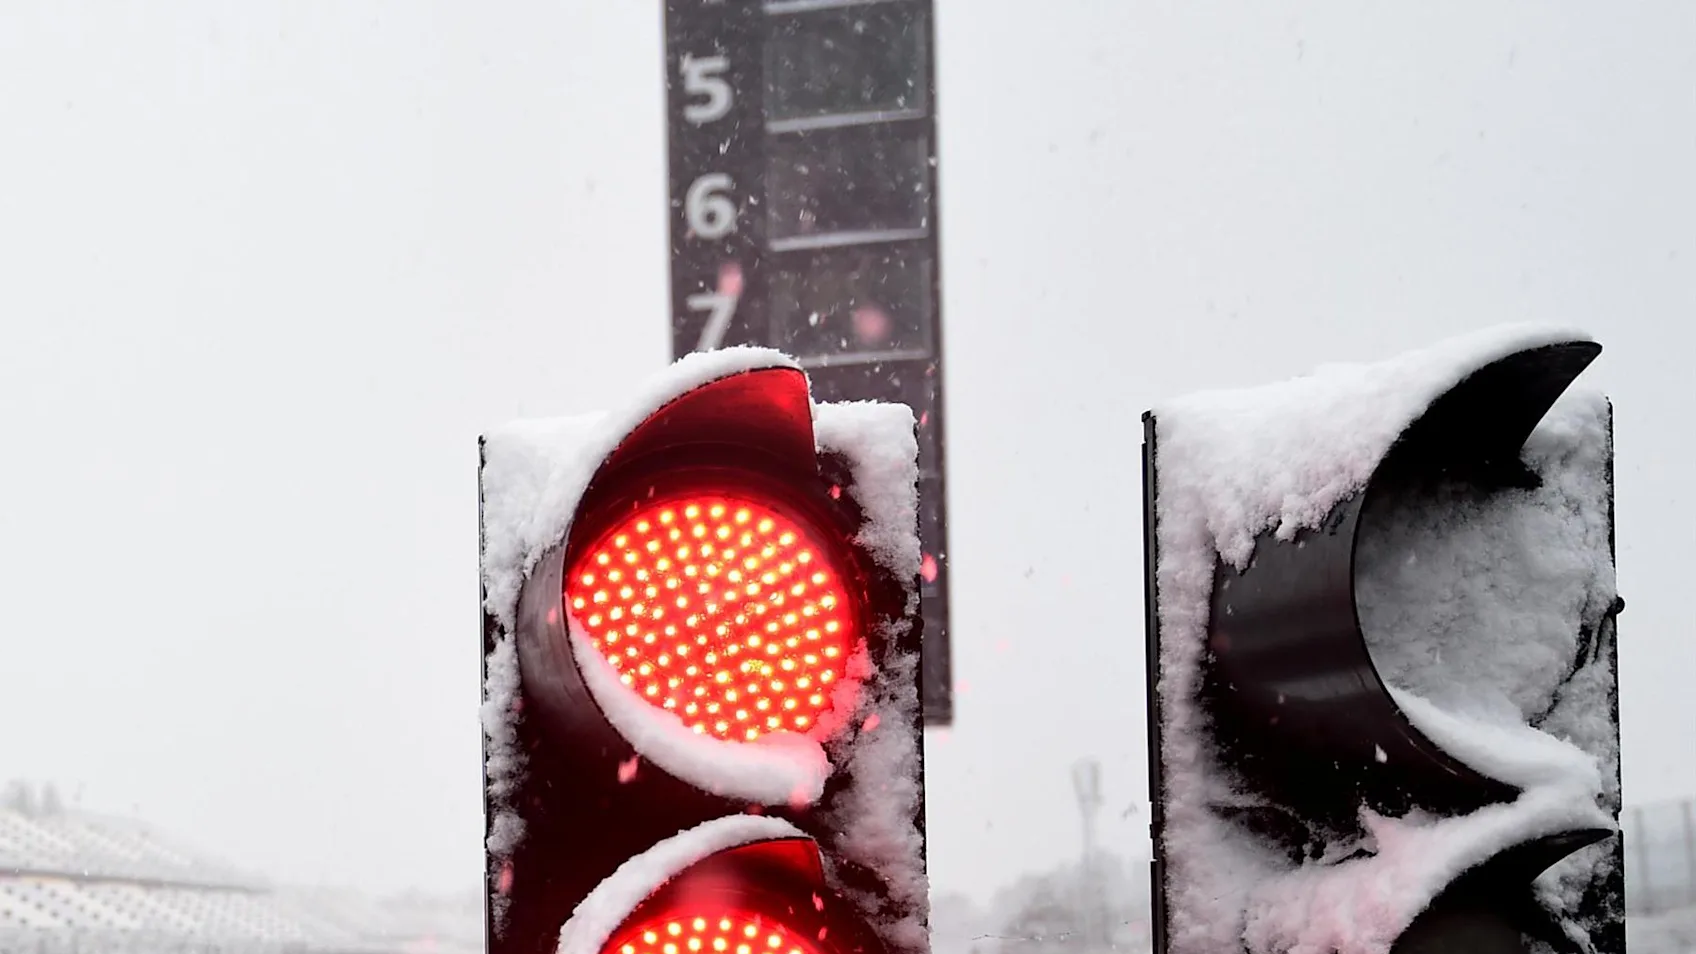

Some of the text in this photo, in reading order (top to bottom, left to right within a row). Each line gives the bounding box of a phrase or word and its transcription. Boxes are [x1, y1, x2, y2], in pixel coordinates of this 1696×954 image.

[680, 55, 733, 122] 5
[685, 173, 737, 240] 6
[687, 292, 740, 352] 7
